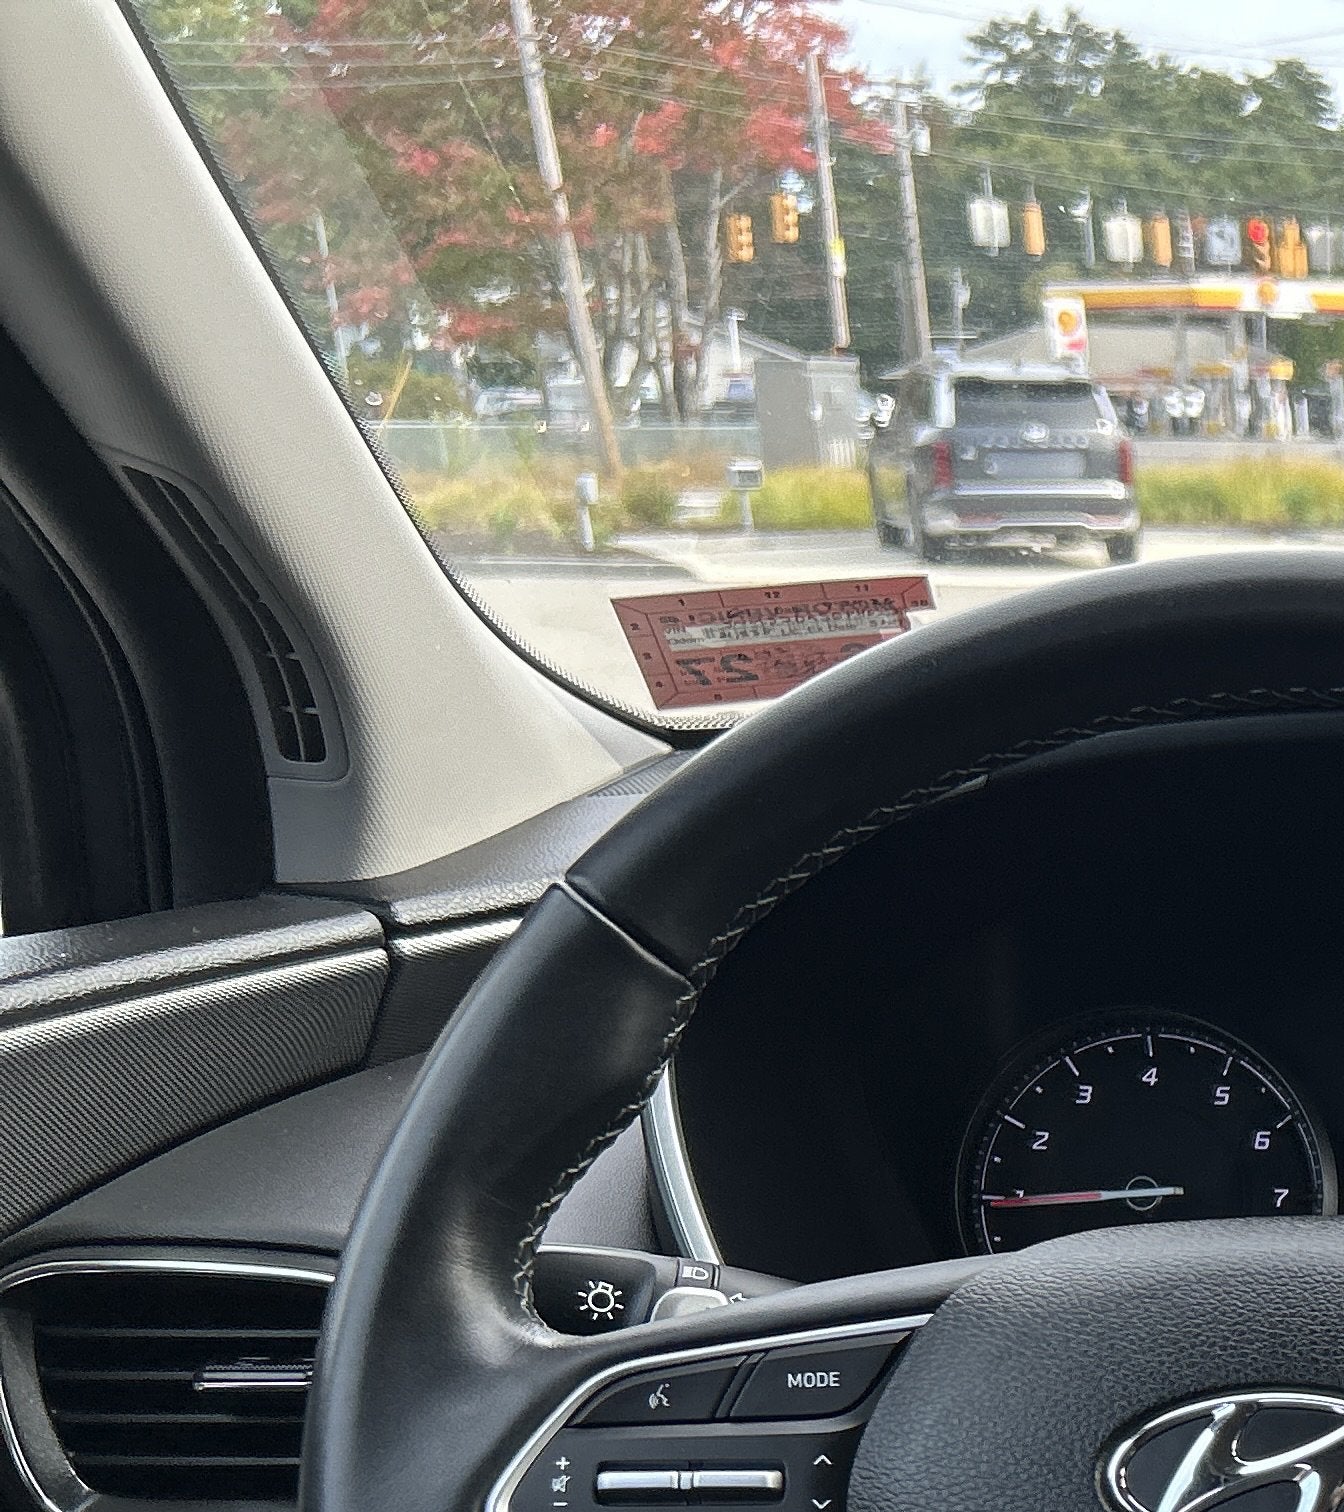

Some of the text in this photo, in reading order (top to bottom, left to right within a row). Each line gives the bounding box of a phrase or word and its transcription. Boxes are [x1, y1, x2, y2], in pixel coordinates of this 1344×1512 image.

[1141, 1068, 1158, 1086] 4
[1075, 1085, 1093, 1104] 3
[1214, 1086, 1231, 1106] 5
[1032, 1131, 1049, 1150] 2
[1254, 1131, 1271, 1150] 6
[1273, 1188, 1289, 1208] 7
[787, 1371, 840, 1389] MODE
